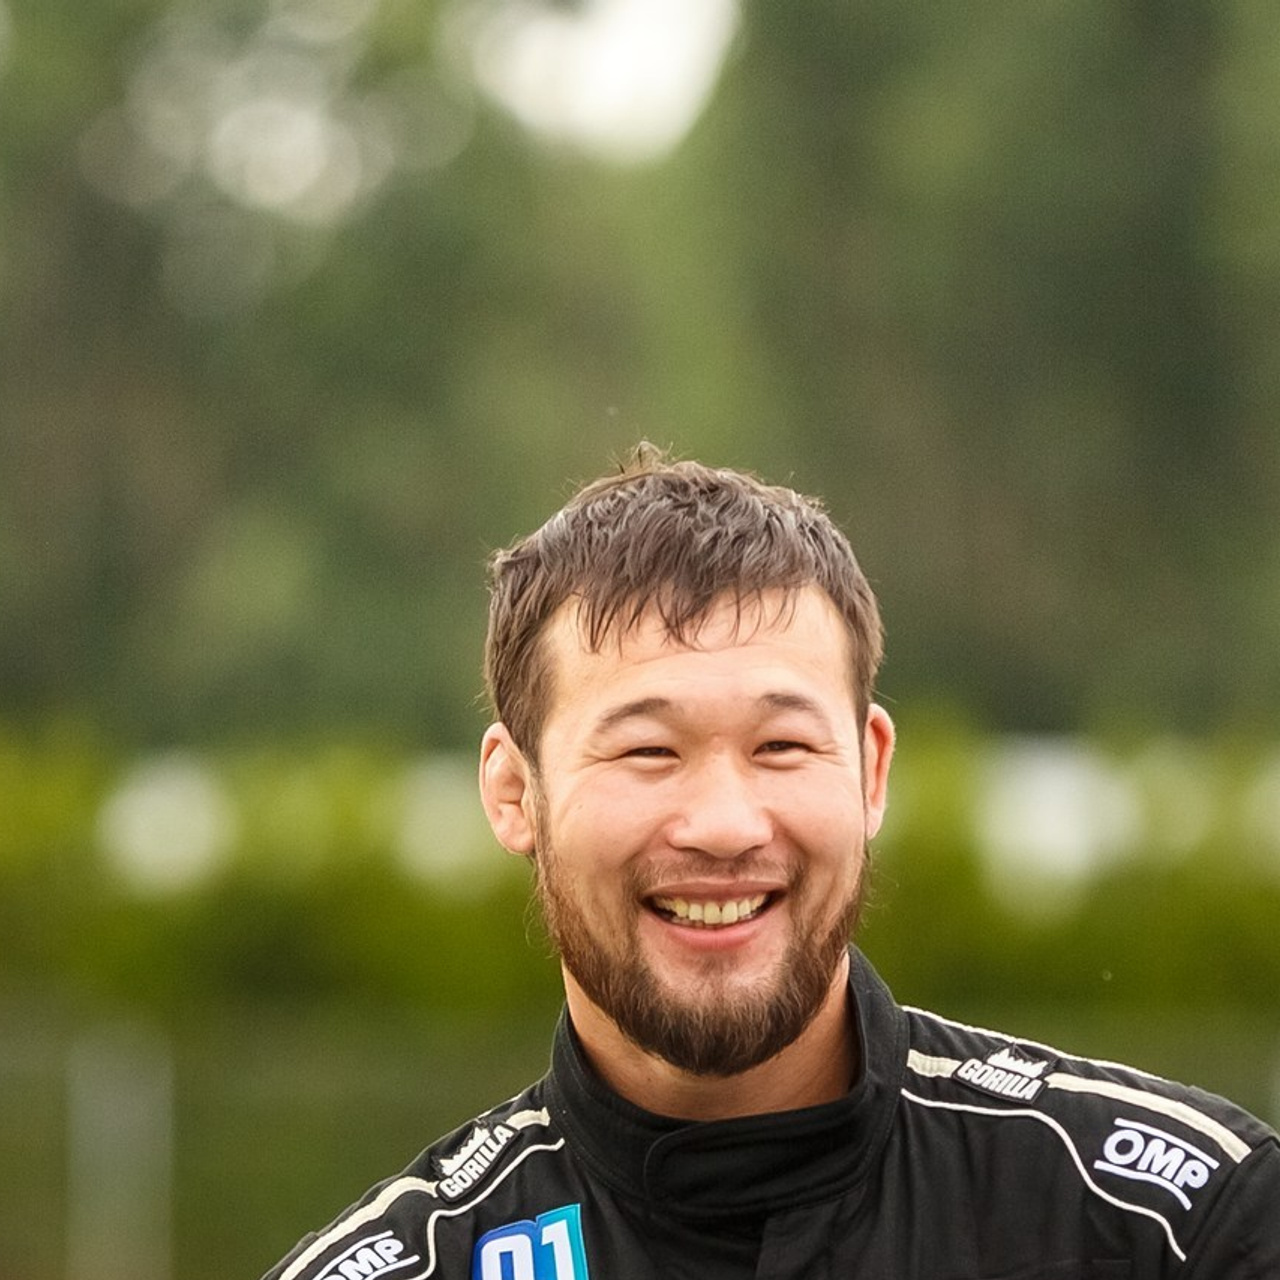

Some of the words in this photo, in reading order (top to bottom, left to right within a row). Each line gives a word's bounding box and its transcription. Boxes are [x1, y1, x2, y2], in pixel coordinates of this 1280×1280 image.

[957, 1060, 1042, 1101] GORILLA
[439, 1124, 514, 1199] GORILLA
[1103, 1129, 1209, 1189] OMP
